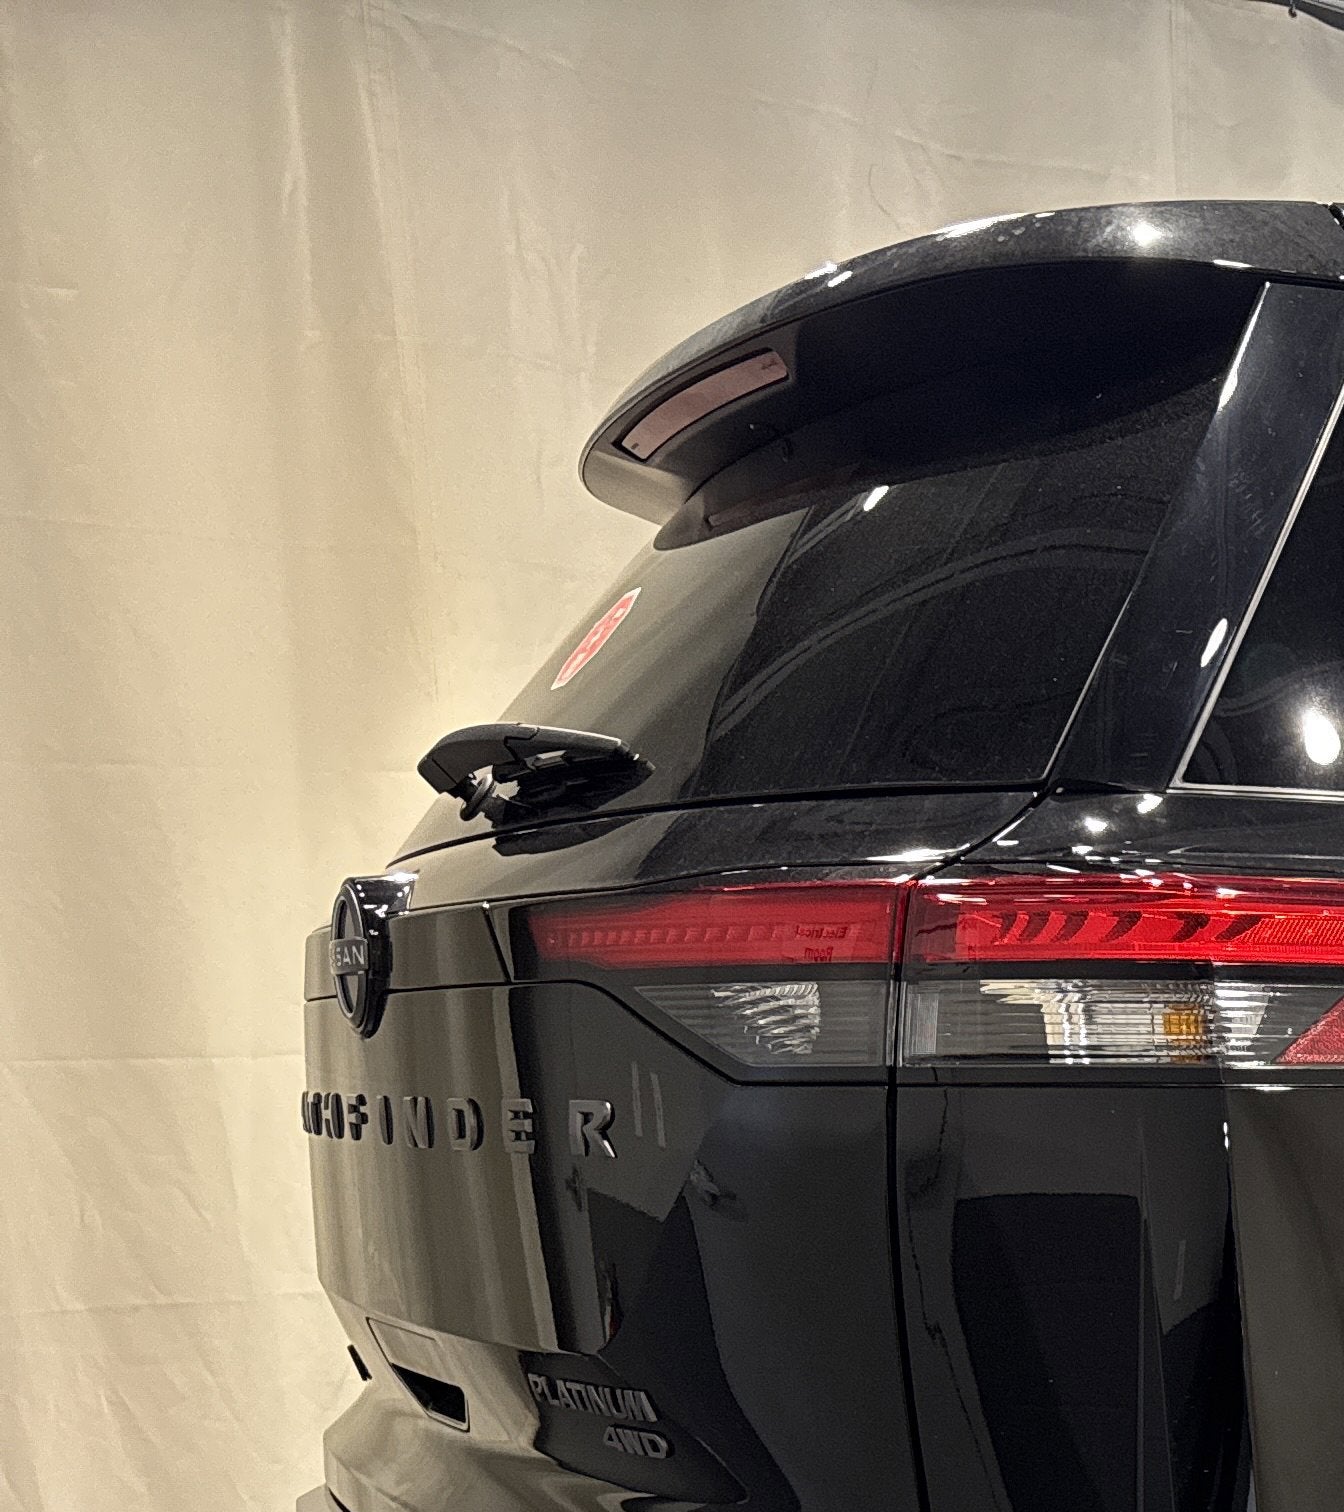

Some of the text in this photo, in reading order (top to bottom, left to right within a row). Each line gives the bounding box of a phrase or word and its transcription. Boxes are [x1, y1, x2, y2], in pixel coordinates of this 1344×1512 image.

[301, 1091, 618, 1159] THFINDER
[527, 1373, 658, 1423] PLATINUM
[603, 1425, 668, 1460] 4WD
